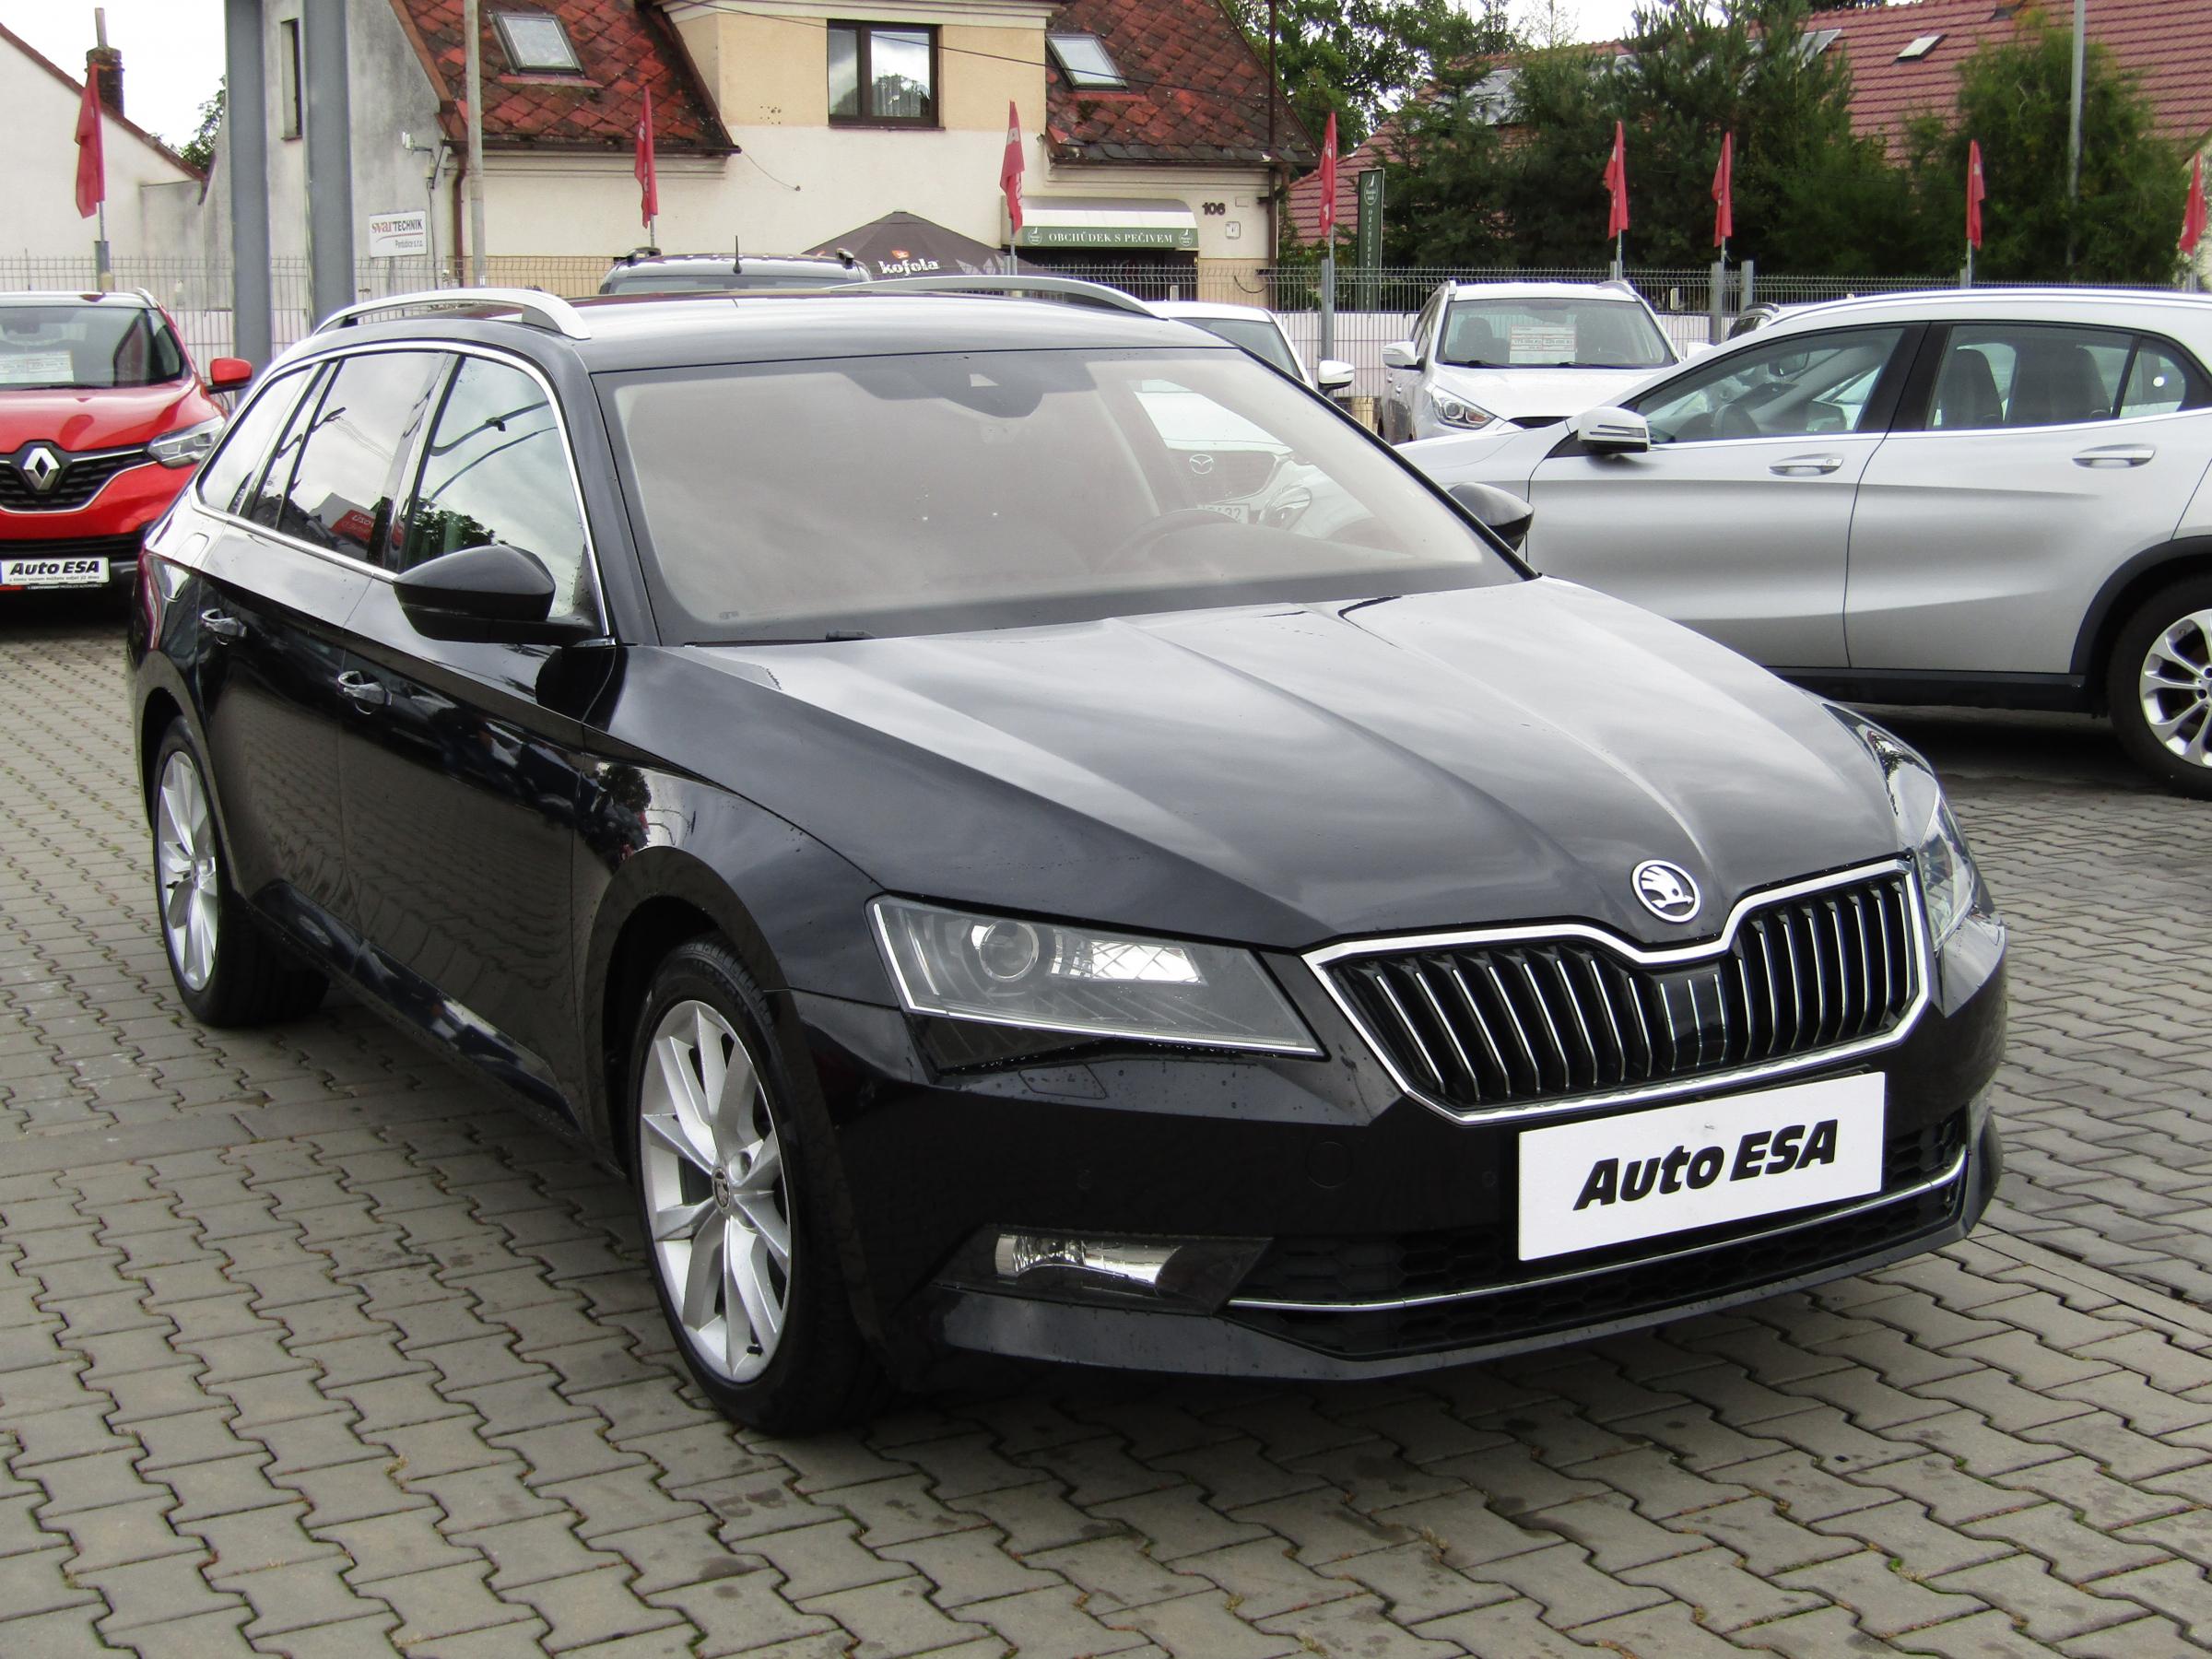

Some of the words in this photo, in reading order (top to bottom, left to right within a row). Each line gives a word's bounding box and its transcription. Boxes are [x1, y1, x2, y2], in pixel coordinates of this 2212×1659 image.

[1202, 202, 1226, 216] 106
[1048, 231, 1112, 242] OBCHŮDEK
[1114, 234, 1121, 242] S
[1124, 232, 1172, 243] PEČIVEM
[878, 258, 939, 276] kofola
[10, 562, 60, 575] Auto
[62, 560, 100, 573] ESA
[1572, 1145, 1725, 1211] Auto
[1729, 1118, 1839, 1182] ESA
